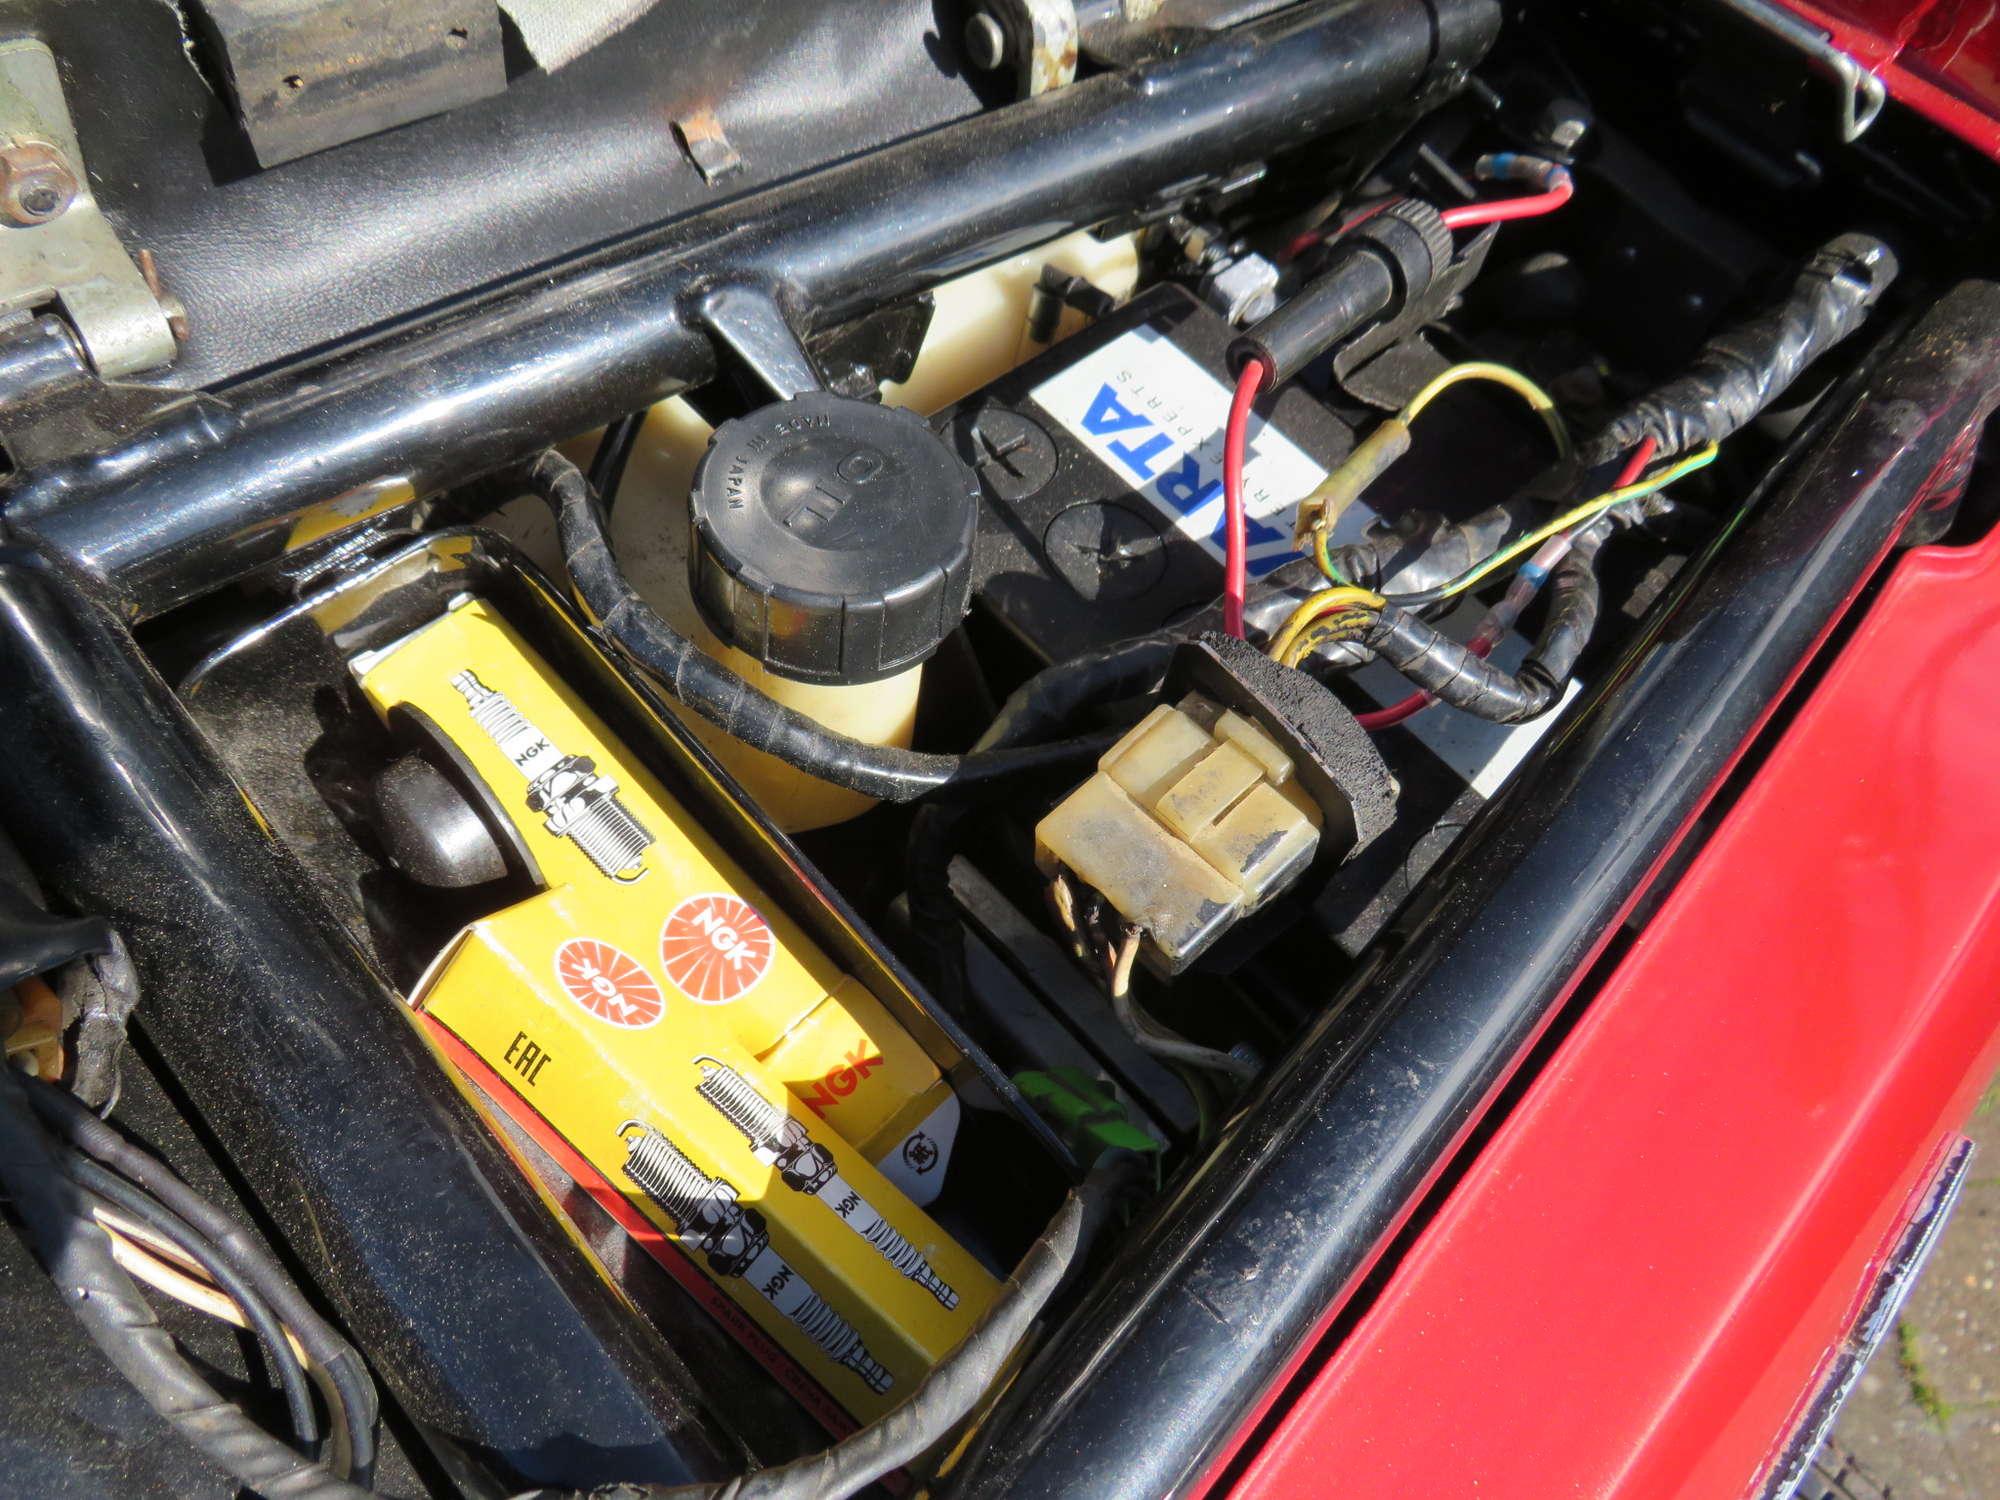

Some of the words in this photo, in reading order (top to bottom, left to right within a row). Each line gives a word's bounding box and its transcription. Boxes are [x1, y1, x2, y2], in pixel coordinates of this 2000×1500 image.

[774, 413, 832, 436] MADE
[1116, 370, 1224, 466] EXPERTS
[726, 454, 748, 510] JAPAN
[514, 738, 550, 766] NGK
[691, 906, 757, 970] NGK
[571, 957, 640, 1018] NGK
[503, 1030, 552, 1087] EAC
[800, 1039, 884, 1119] NGK
[834, 1190, 861, 1219] NGK
[762, 1264, 795, 1301] NGK
